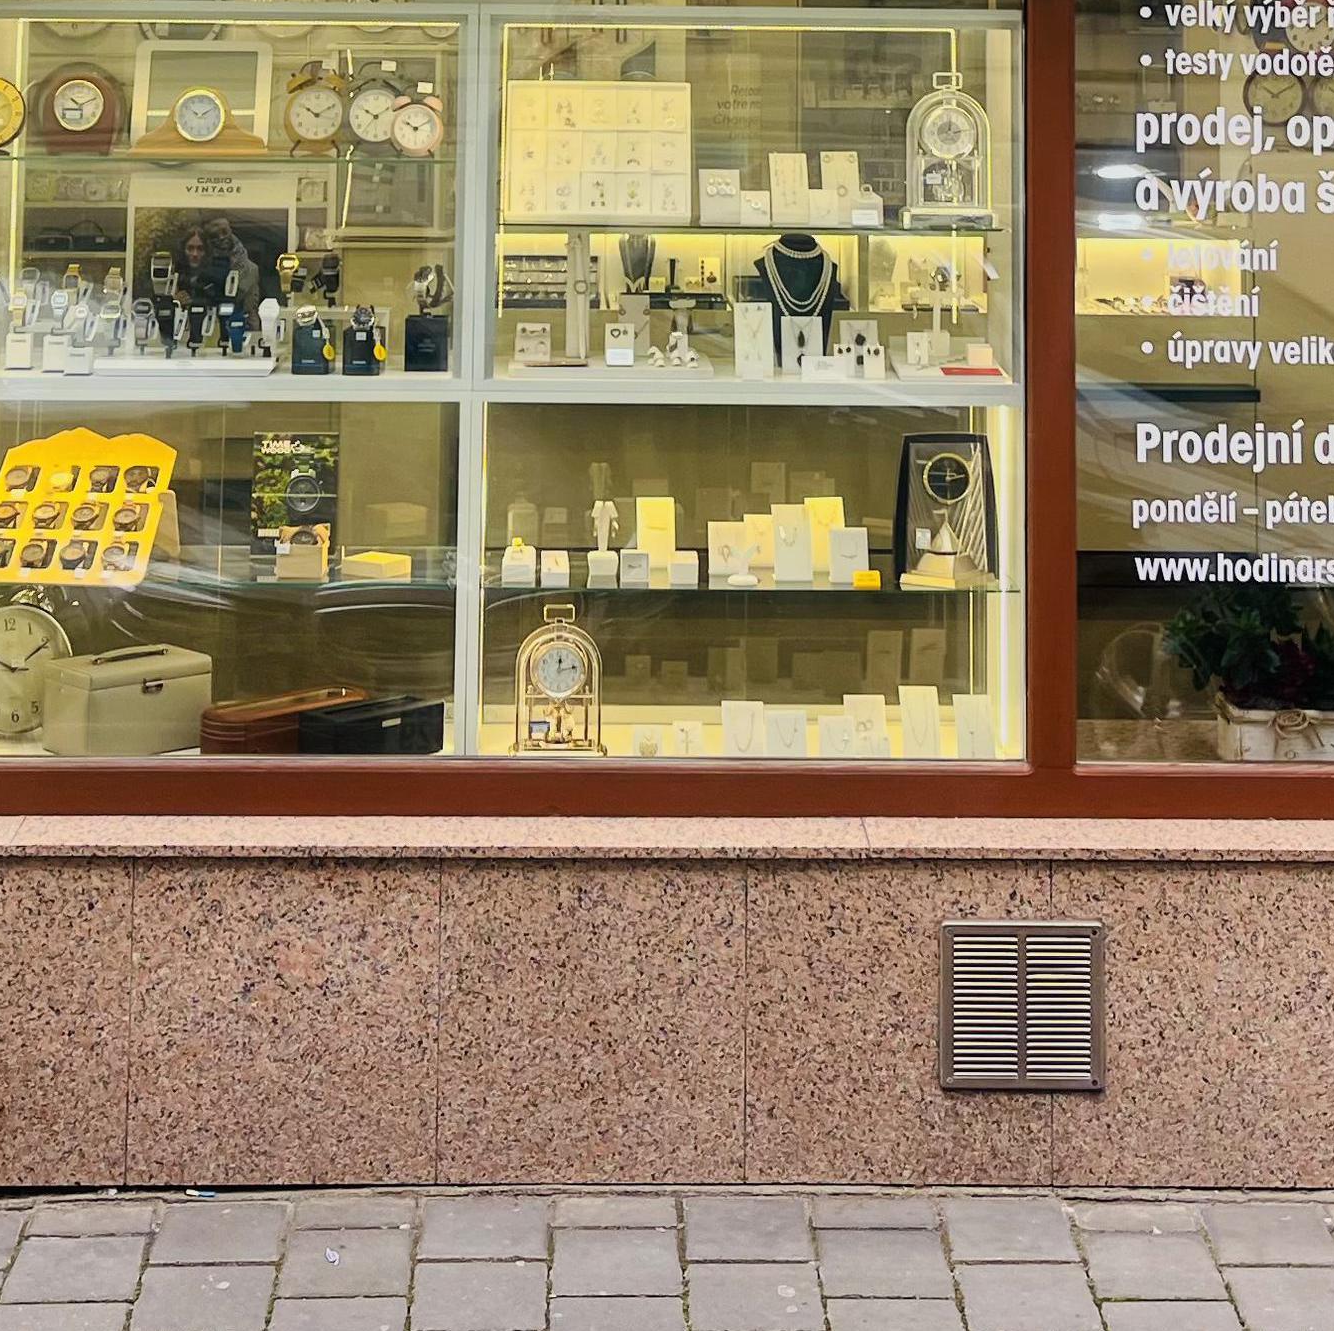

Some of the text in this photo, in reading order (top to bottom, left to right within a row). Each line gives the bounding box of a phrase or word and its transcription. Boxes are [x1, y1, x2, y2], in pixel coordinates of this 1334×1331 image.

[1165, 48, 1234, 82] testy
[1136, 106, 1276, 155] prodej,
[185, 186, 242, 194] VINTAGE
[1136, 178, 1159, 212] a
[1171, 167, 1306, 221] výroba
[1167, 239, 1279, 272] letování
[1167, 285, 1261, 318] čištění
[1167, 331, 1262, 370] úpravy
[1136, 418, 1305, 473] Prodejní
[1132, 491, 1238, 529] pondělí
